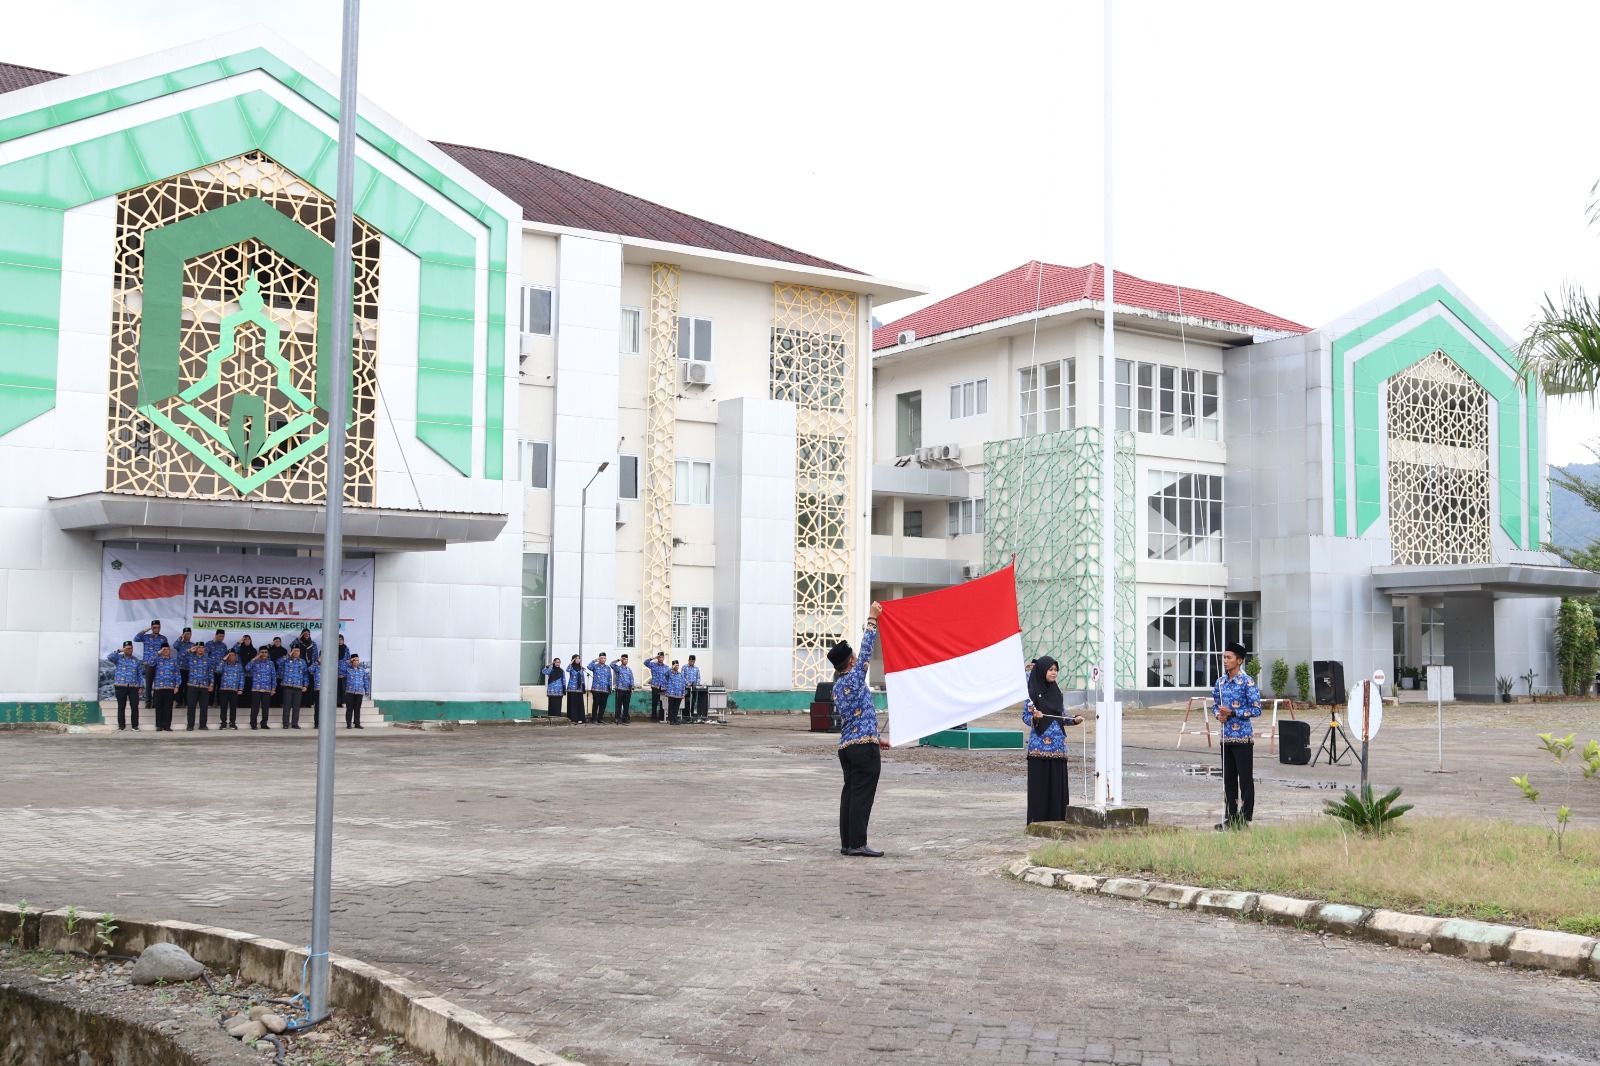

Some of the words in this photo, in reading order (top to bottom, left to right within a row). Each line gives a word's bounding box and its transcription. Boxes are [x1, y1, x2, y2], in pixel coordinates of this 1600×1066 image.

[194, 574, 253, 584] UPACARA
[256, 575, 313, 585] BENDERA
[194, 585, 238, 598] HARI
[244, 586, 356, 601] KESADAN
[193, 599, 299, 615] NASIONAL
[198, 620, 251, 628] UNIVERSITAS
[253, 621, 278, 629] ISLAM
[1093, 668, 1098, 679] P
